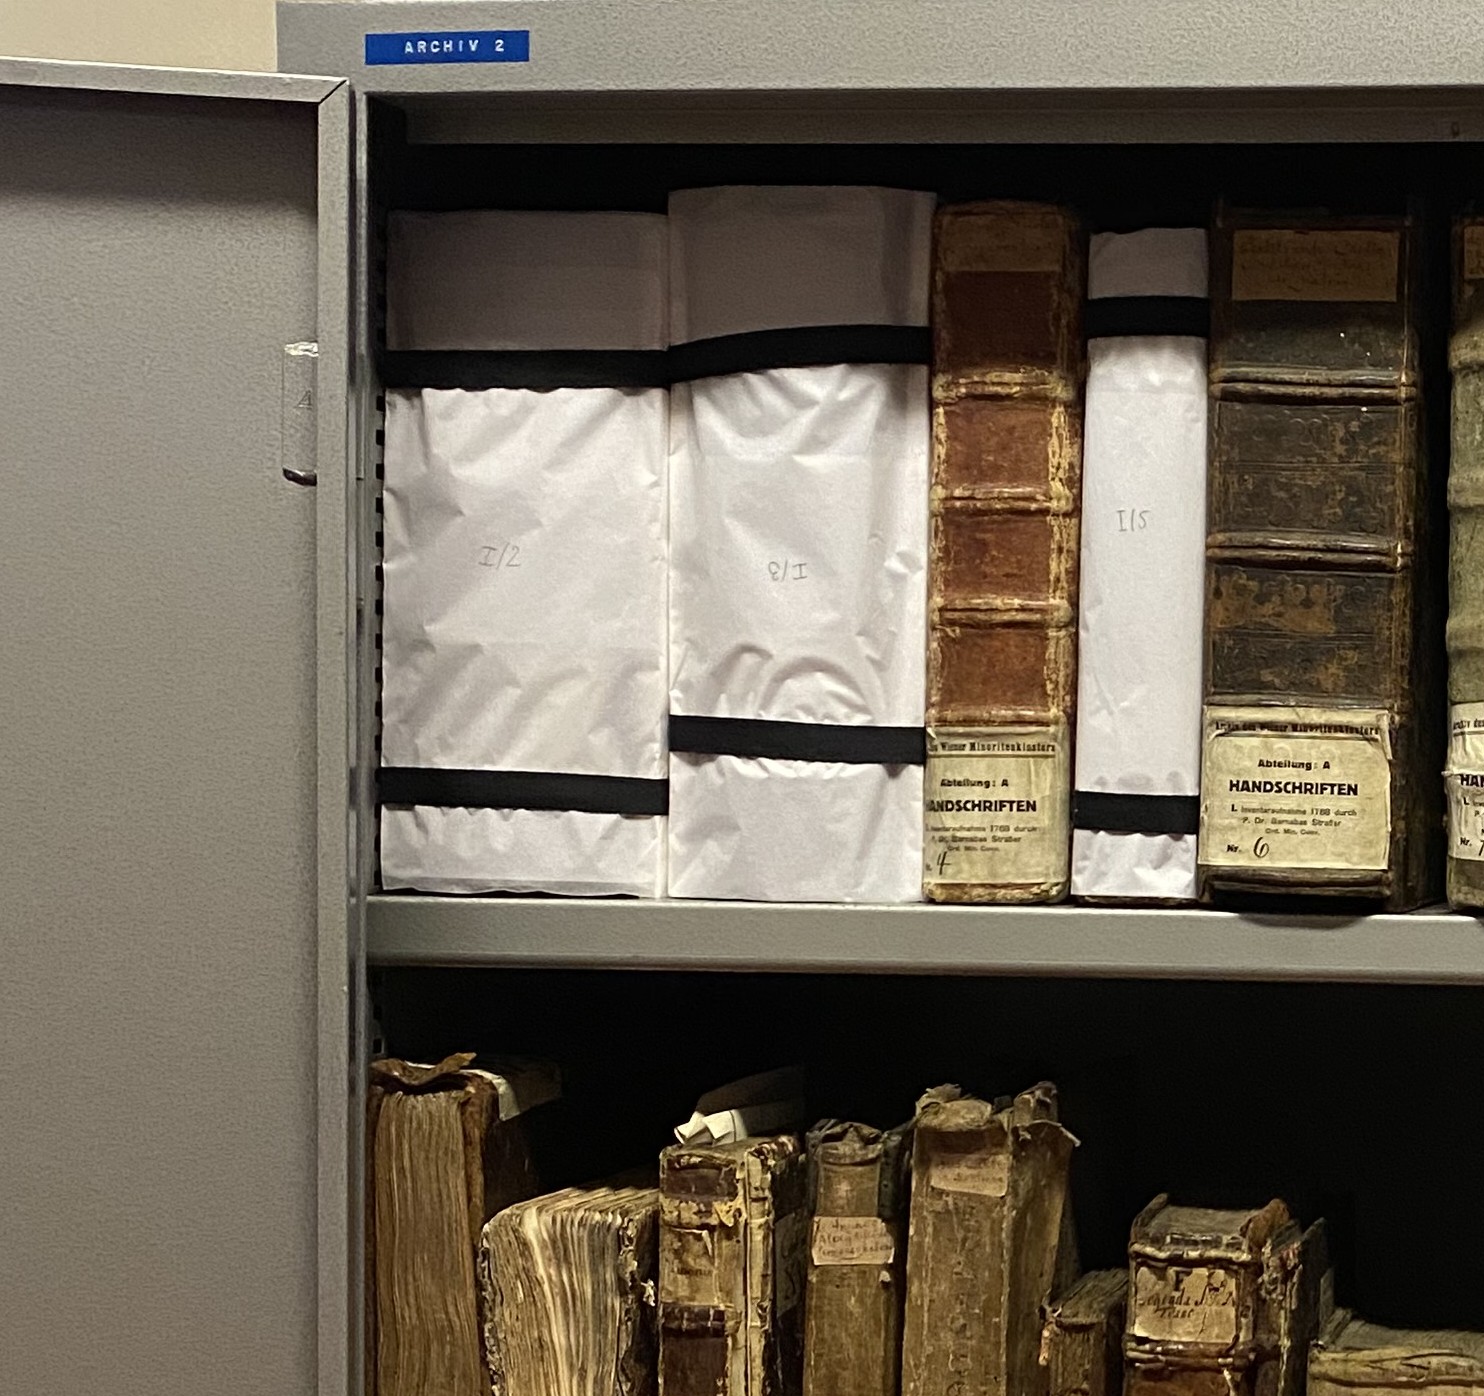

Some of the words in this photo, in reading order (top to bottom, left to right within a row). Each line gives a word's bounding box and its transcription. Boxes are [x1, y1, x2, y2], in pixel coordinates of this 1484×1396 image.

[404, 38, 479, 54] ARCHIV
[494, 39, 505, 52] 2
[479, 544, 521, 569] I/2
[1258, 760, 1318, 770] Abteilung:
[941, 779, 996, 788] Abteilung:
[1001, 779, 1008, 787] A
[1229, 780, 1358, 795] HANDSCHRIFTEN
[926, 800, 1036, 812] ANDSCHRIFTEN
[1254, 837, 1269, 858] 6
[1460, 837, 1472, 846] Nr.
[937, 852, 951, 875] 4
